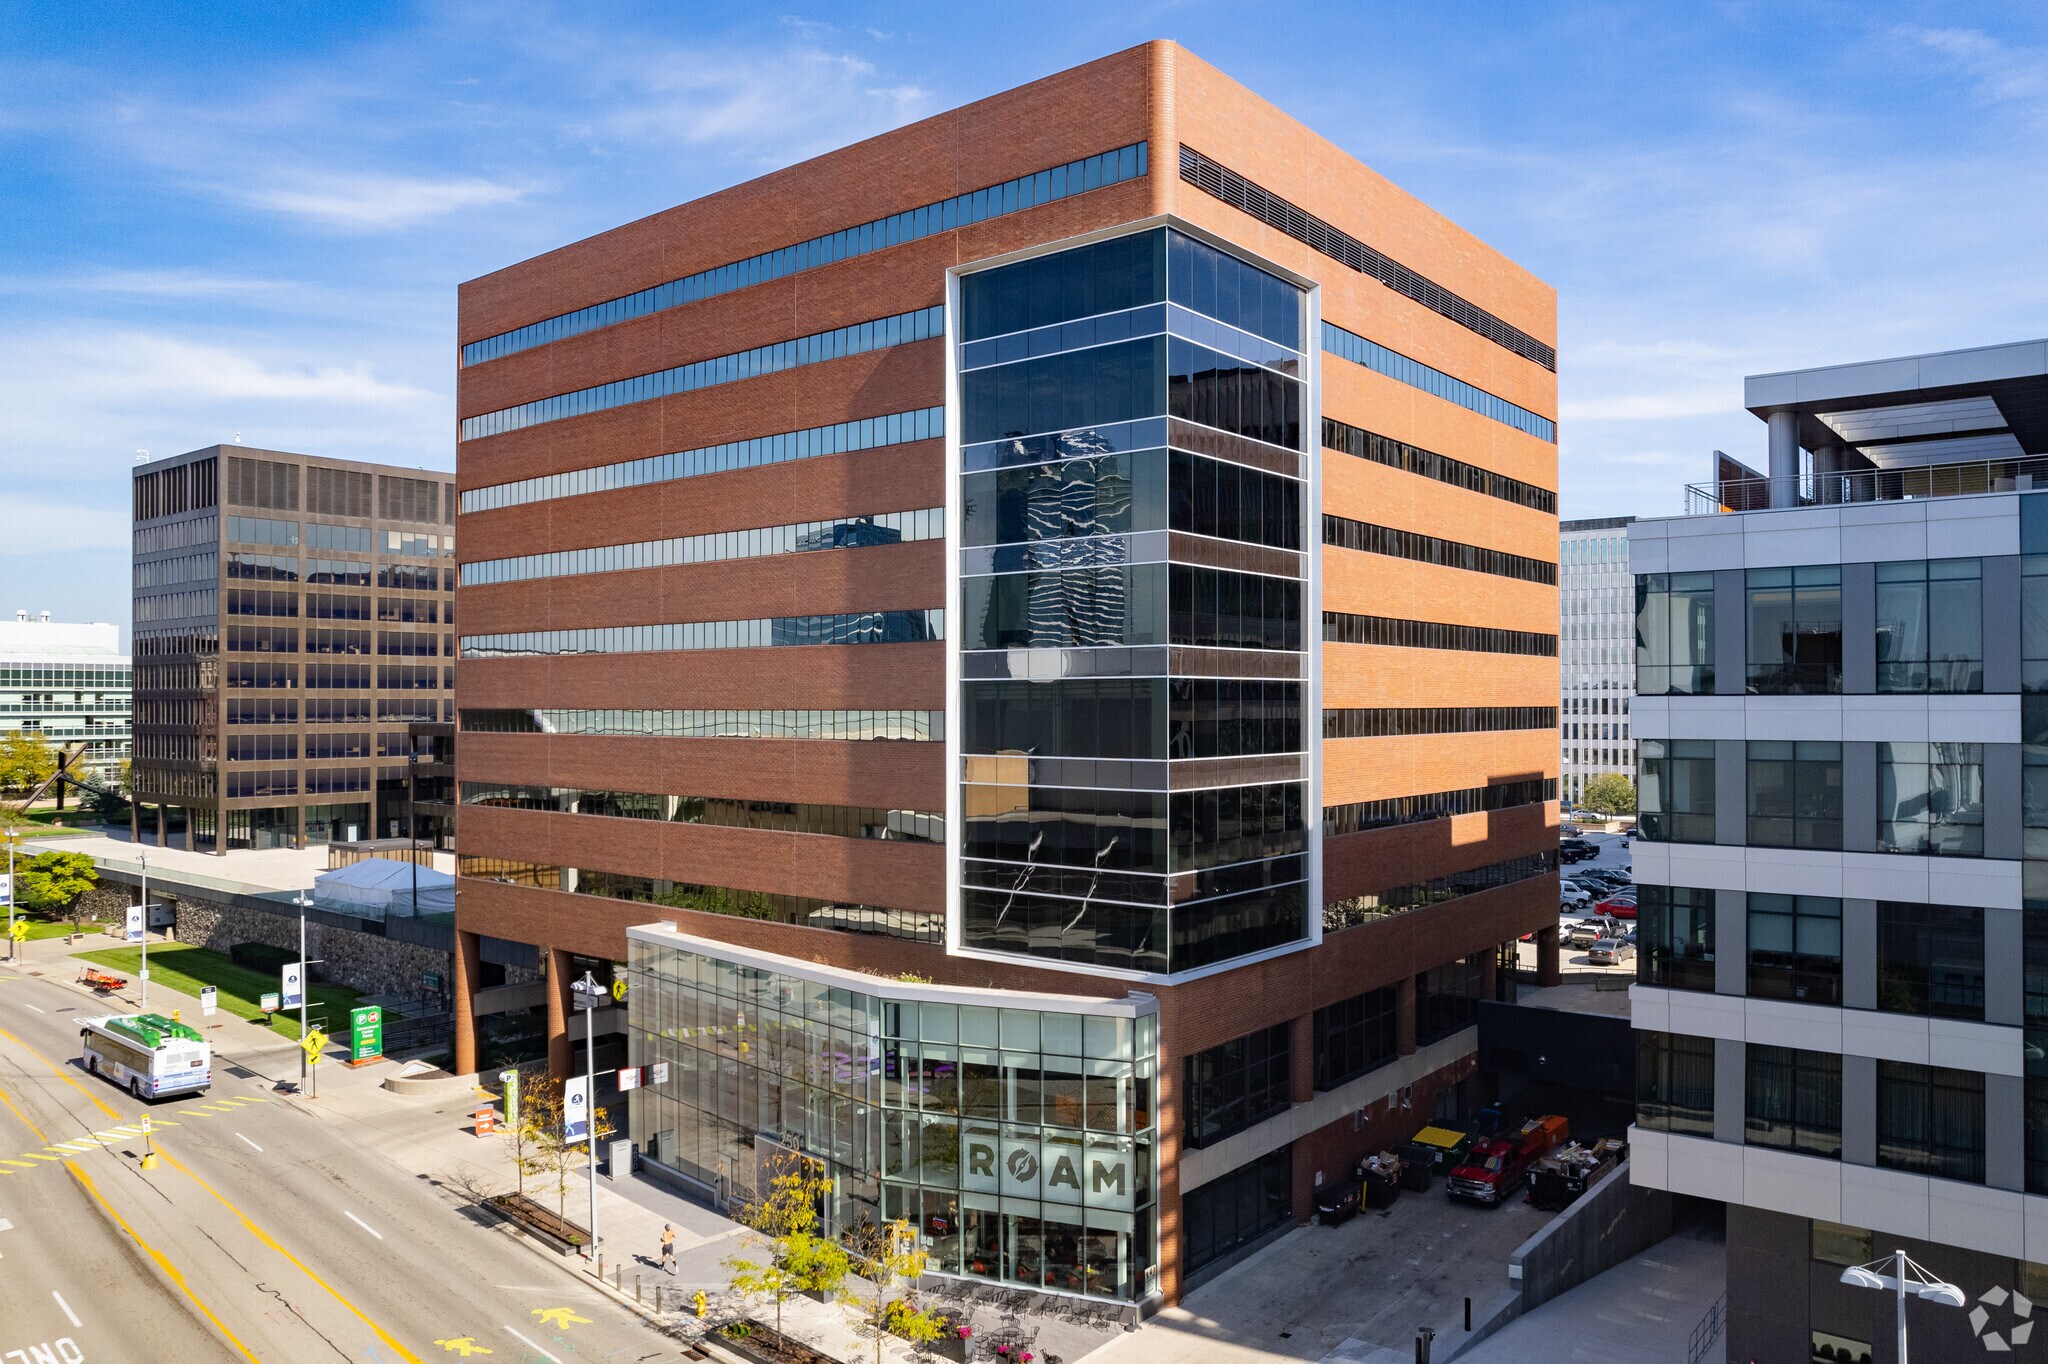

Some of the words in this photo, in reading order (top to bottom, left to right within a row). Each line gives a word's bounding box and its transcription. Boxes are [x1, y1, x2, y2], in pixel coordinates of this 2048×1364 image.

[780, 1131, 799, 1151] 250
[969, 1142, 1126, 1196] ROAM
[0, 1337, 84, 1364] ONL
